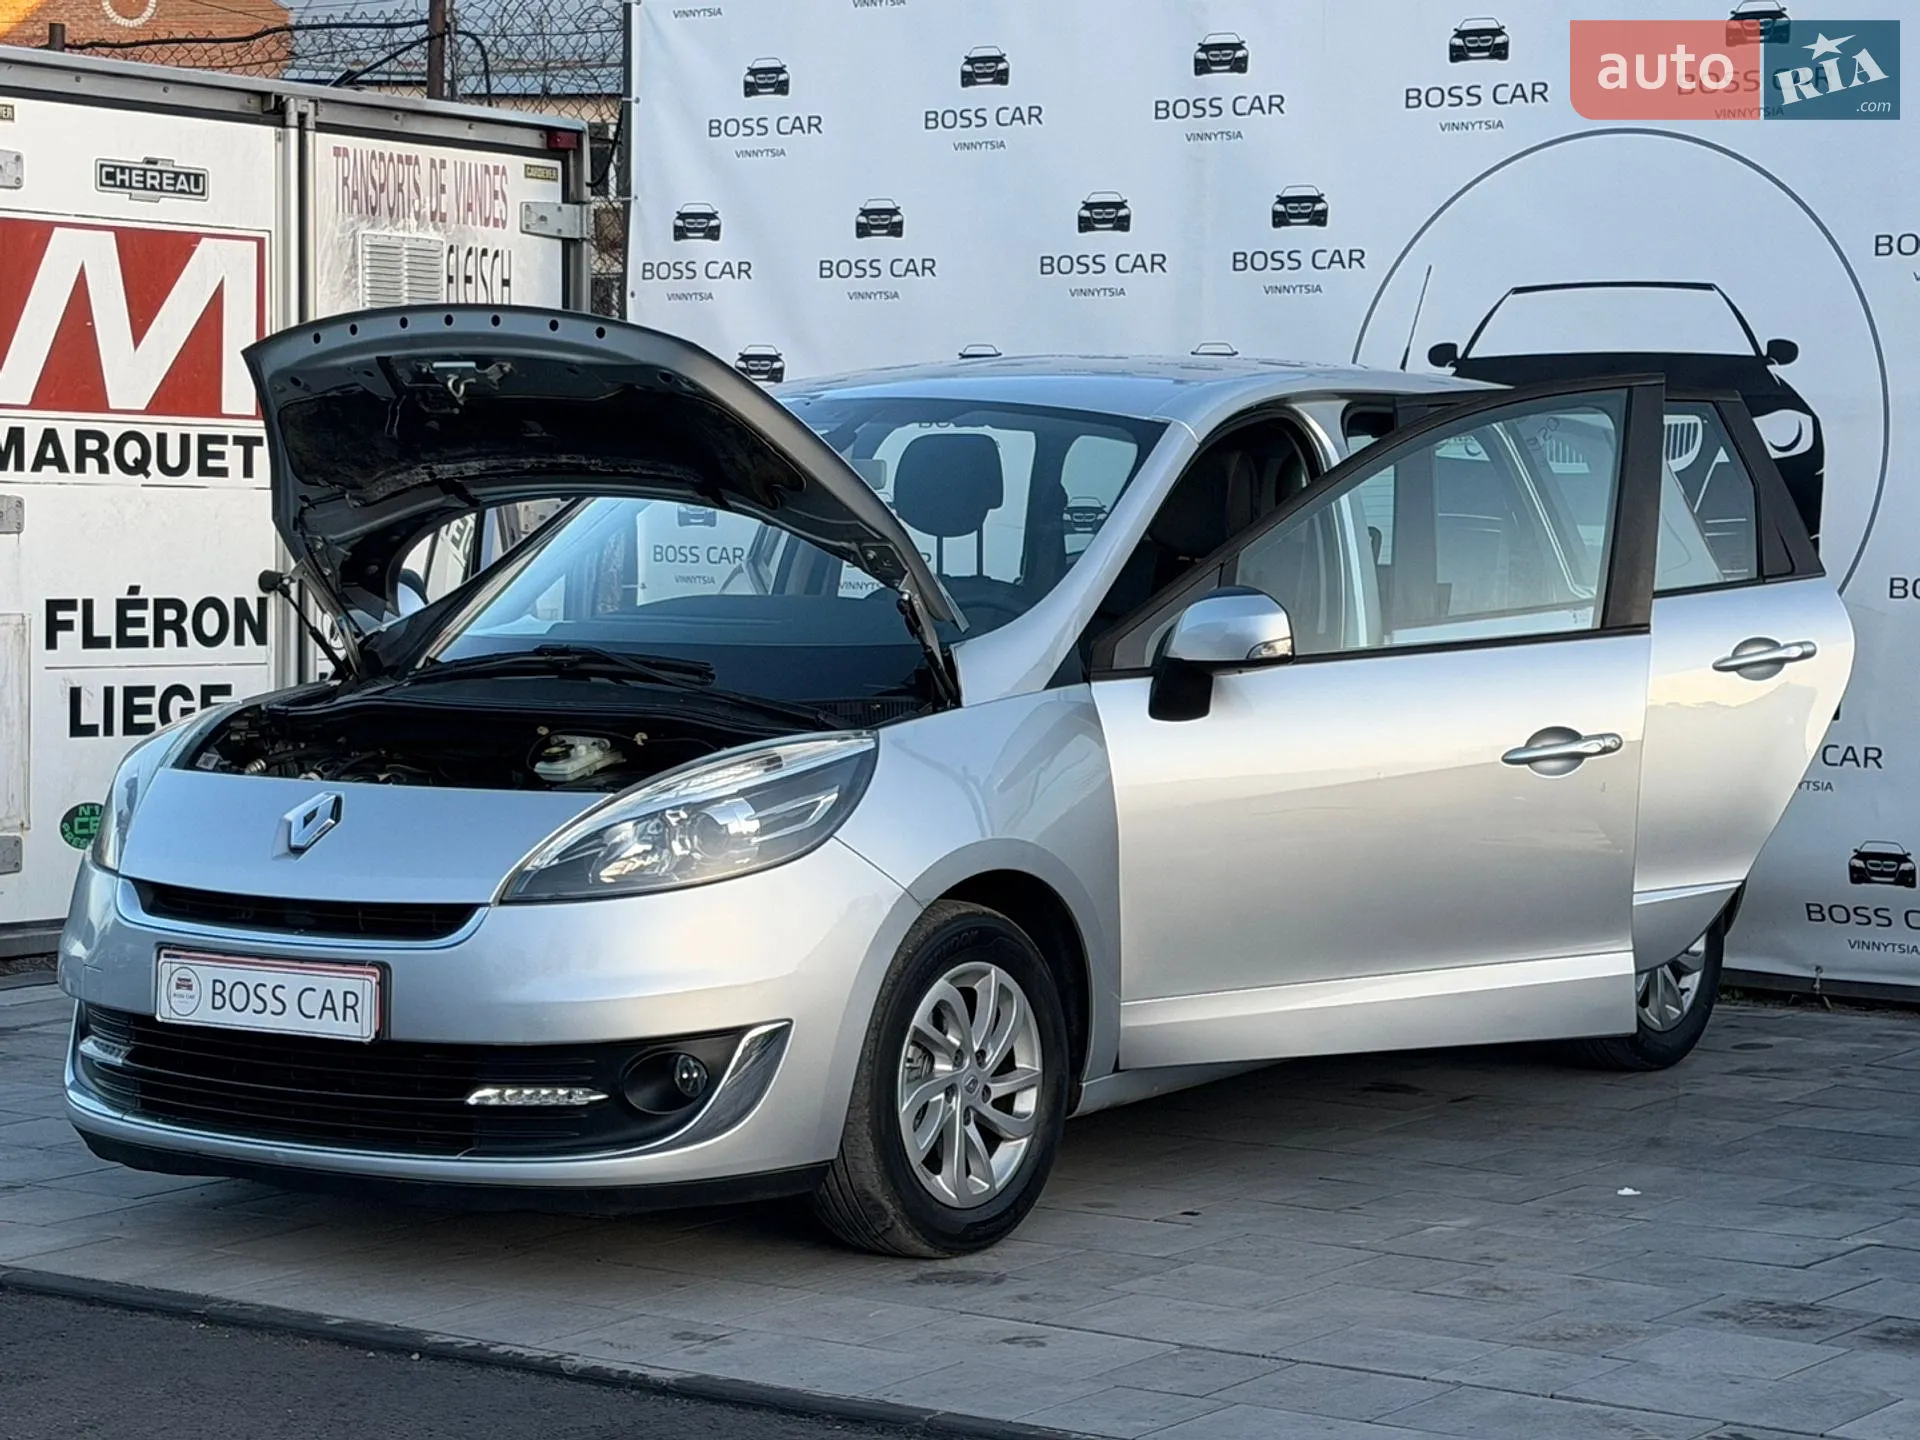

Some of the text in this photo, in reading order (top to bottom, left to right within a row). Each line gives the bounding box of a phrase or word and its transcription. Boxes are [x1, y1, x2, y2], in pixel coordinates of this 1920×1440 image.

[673, 8, 722, 18] VINNYTSIA
[1406, 82, 1548, 108] BOSS CAR
[1155, 95, 1284, 119] BOSS CAR
[709, 116, 822, 137] BOSS CAR
[925, 106, 1042, 129] BOSS CAR
[1440, 120, 1504, 131] VINNYTSIA
[953, 141, 1006, 151] VINNYTSIA
[1186, 131, 1243, 141] VINNYTSIA
[735, 149, 785, 158] VINNYTSIA
[101, 166, 204, 194] CHEREAU
[333, 146, 508, 230] TRANSPORTS DE VIANDES
[1875, 234, 1920, 256] BO
[820, 259, 936, 278] BOSS CAR
[1040, 254, 1166, 275] BOSS CAR
[1233, 249, 1365, 271] BOSS CAR
[642, 261, 751, 280] BOSS CAR
[667, 292, 713, 301] VINNYTSIA
[848, 291, 899, 300] VINNYTSIA
[1069, 288, 1125, 297] VINNYTSIA
[1264, 284, 1322, 294] VINNYTSIA
[0, 427, 264, 479] MARQUET
[654, 545, 744, 565] BOSS CAR
[675, 576, 715, 584] VINNYTSIA
[45, 585, 268, 650] FLÉRON
[1822, 744, 1883, 769] CAR
[1806, 903, 1892, 927] BOSS
[1848, 939, 1920, 955] VINNYTSIA
[212, 979, 358, 1023] BOSS CAR
